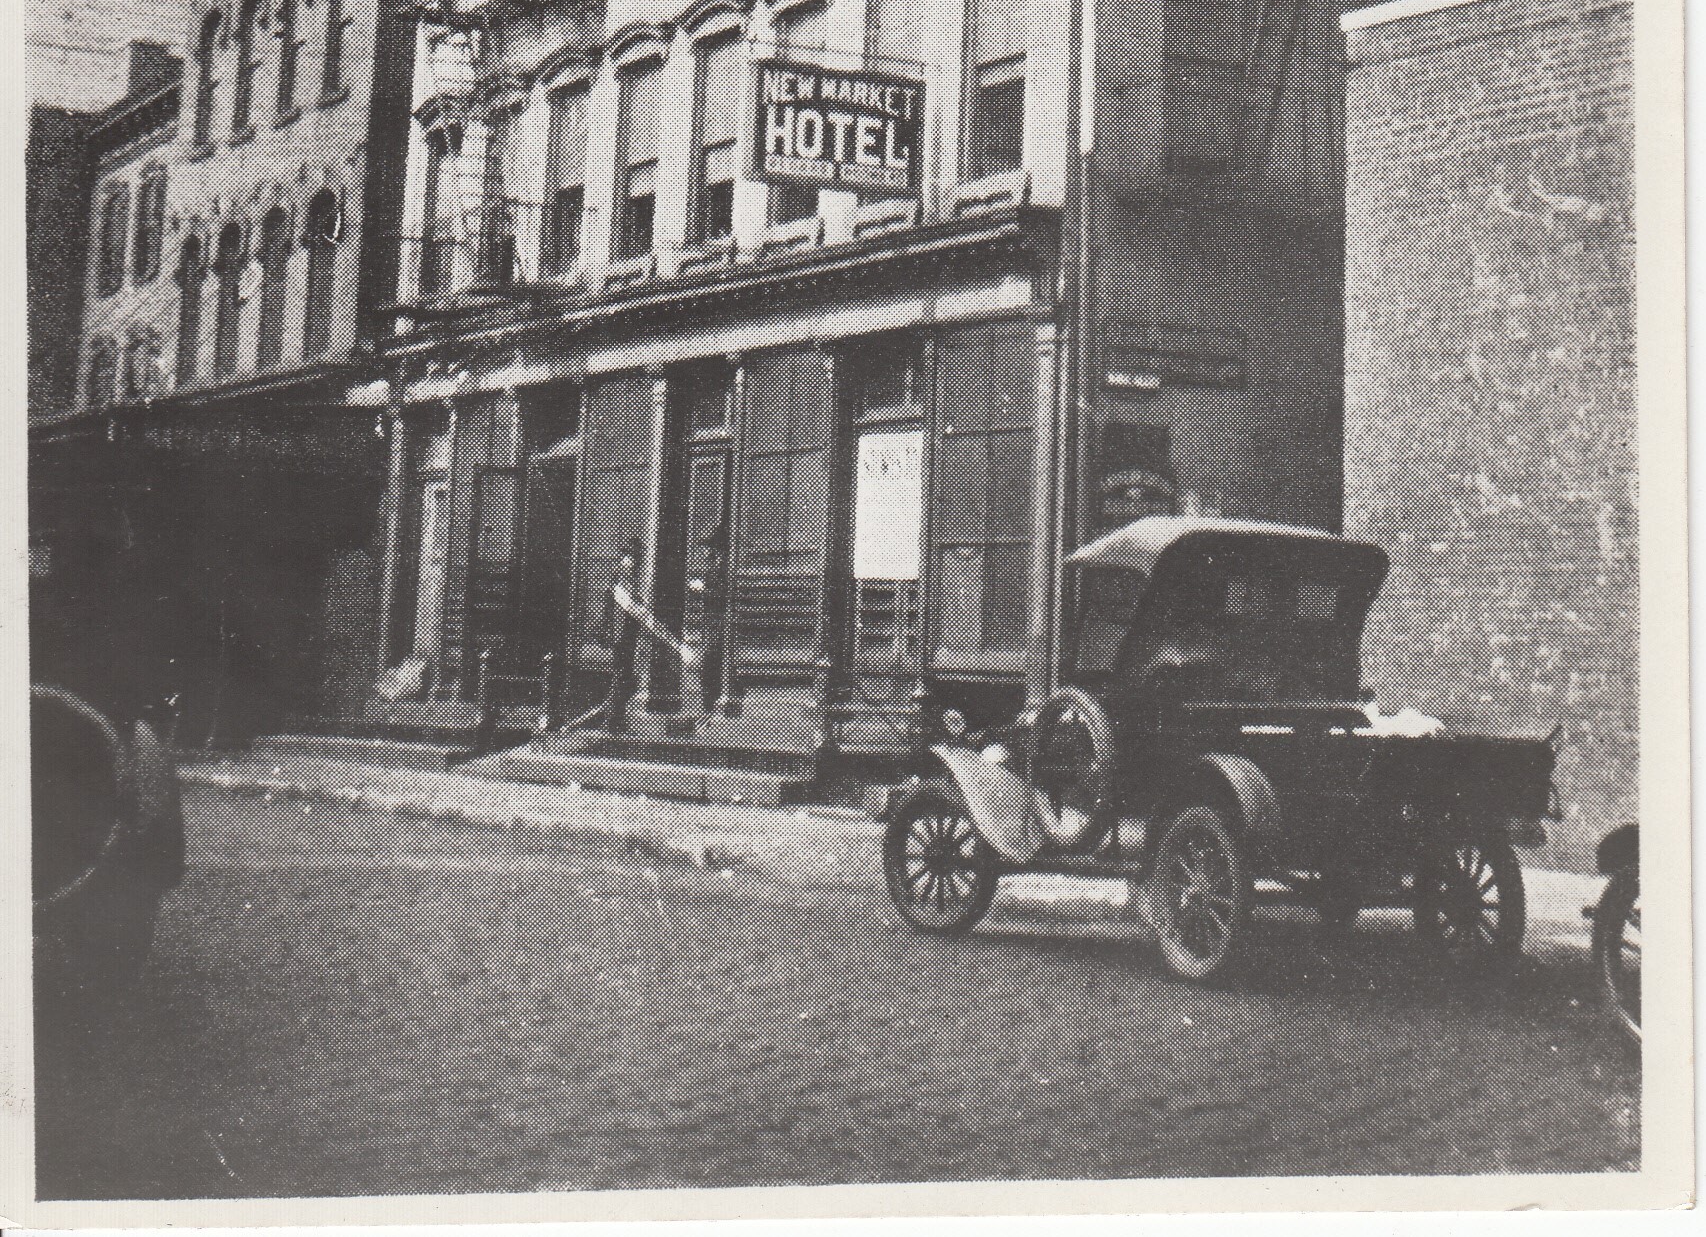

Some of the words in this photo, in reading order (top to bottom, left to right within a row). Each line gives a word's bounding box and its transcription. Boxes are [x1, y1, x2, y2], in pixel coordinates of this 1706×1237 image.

[762, 69, 816, 105] NEW
[820, 78, 917, 121] MARKET
[765, 104, 910, 169] HOTEL
